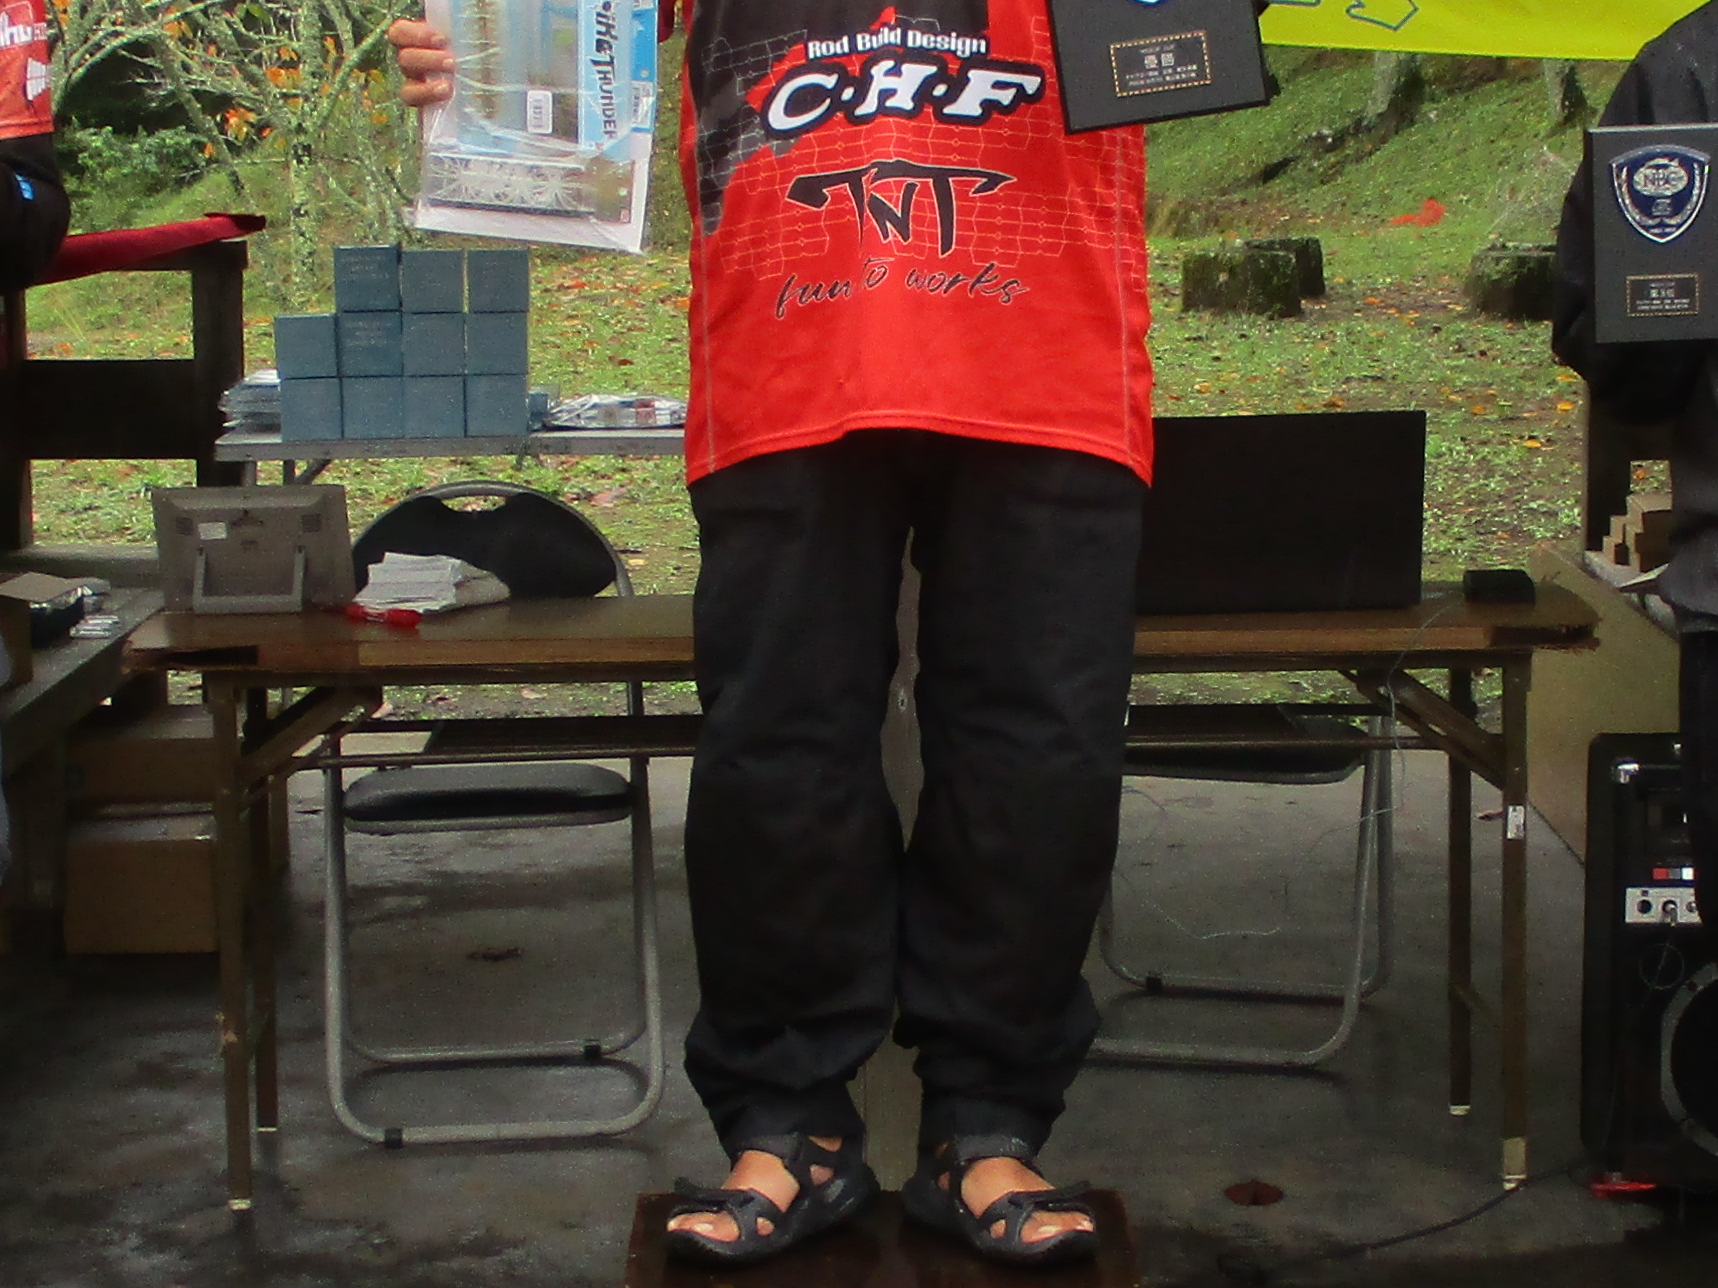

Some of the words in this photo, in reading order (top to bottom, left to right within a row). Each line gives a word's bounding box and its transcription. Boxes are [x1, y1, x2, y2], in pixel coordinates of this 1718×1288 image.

[807, 33, 850, 60] Rod
[855, 26, 901, 54] Build
[908, 28, 987, 59] Design
[774, 274, 851, 320] fun
[903, 262, 1029, 306] works
